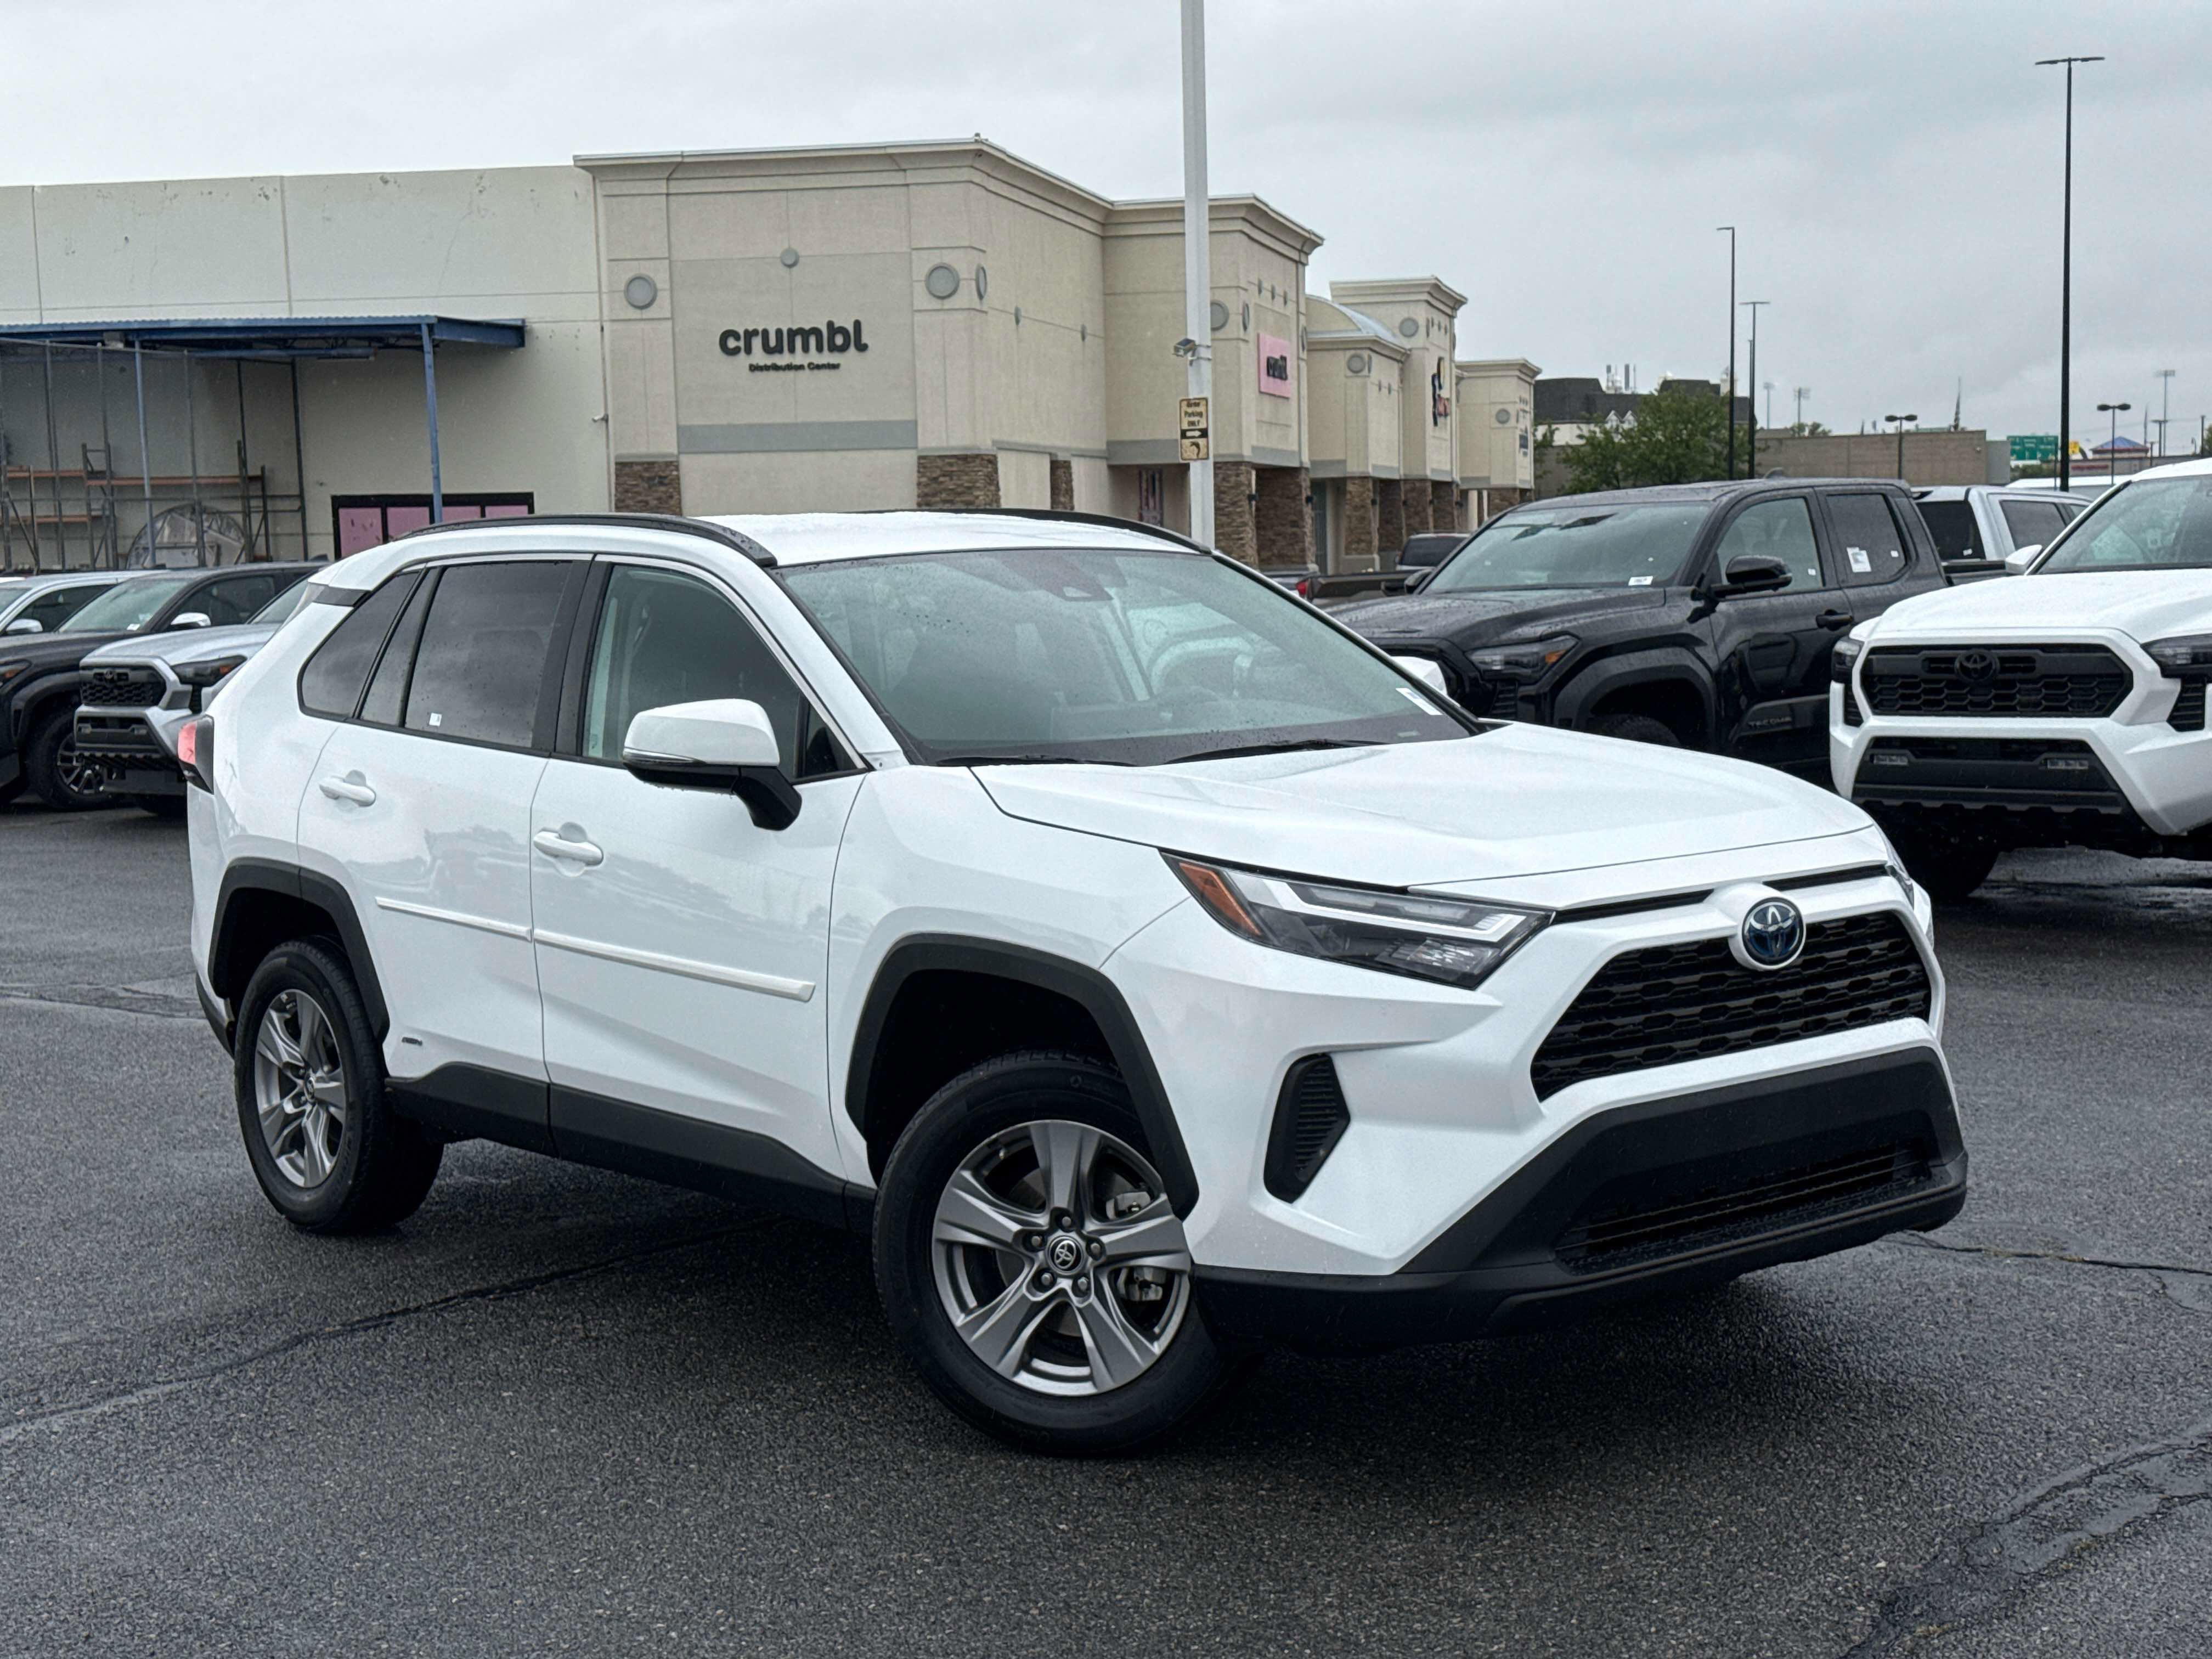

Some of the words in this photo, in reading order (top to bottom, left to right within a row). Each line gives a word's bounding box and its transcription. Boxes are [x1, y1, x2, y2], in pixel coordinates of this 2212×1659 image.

[719, 319, 868, 356] crumbl
[749, 362, 805, 372] Distribution
[808, 362, 840, 370] Center
